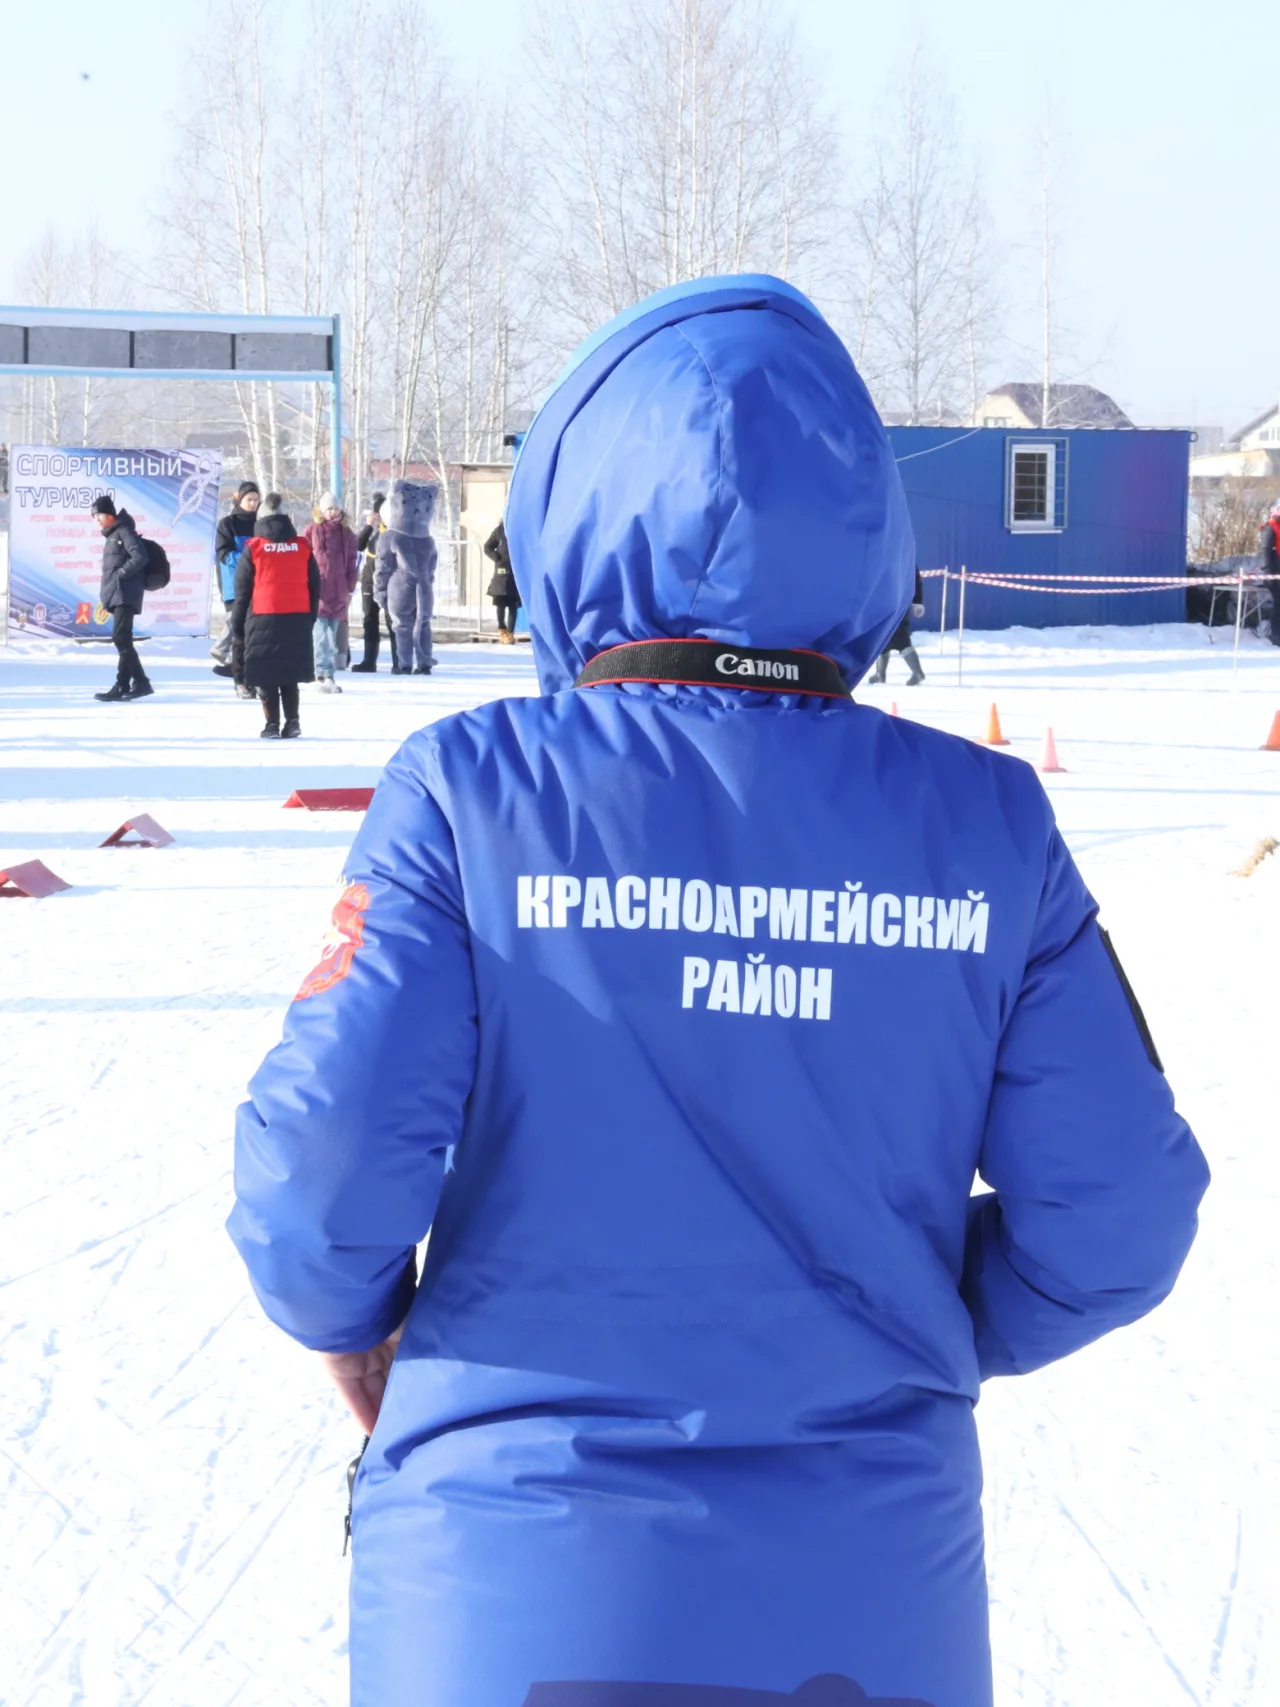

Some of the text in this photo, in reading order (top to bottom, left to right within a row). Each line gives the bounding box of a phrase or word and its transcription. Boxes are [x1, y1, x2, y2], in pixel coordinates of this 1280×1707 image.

[17, 452, 182, 477] СПОРТИВНЫЙ
[264, 543, 298, 553] СУДЬЯ
[715, 653, 800, 681] Canon
[517, 876, 990, 954] КРАСНОАРМЕЙСКИЙ
[682, 953, 833, 1020] РАЙОН
